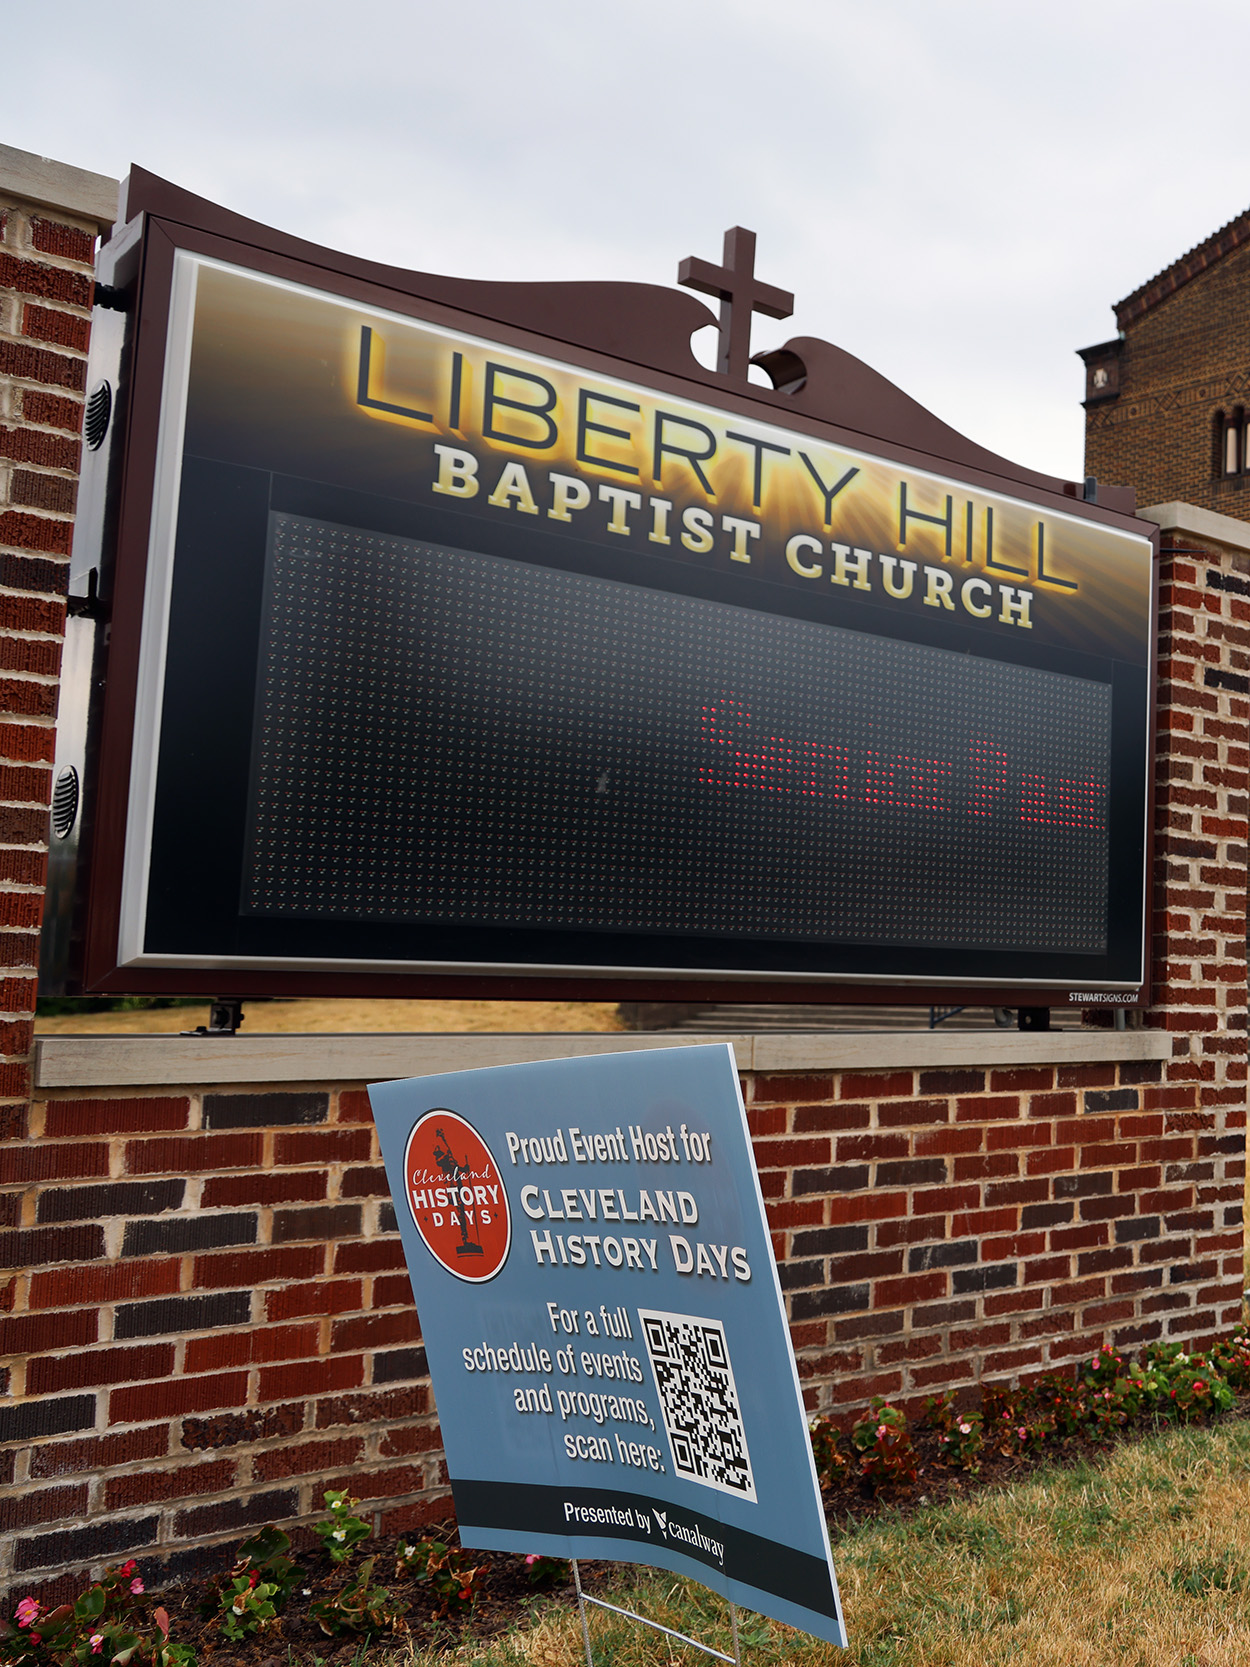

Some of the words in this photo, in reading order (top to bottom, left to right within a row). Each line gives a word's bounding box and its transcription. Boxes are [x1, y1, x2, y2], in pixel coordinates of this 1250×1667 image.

[356, 324, 861, 528] LIBERTY
[897, 480, 1079, 593] HILL
[431, 443, 761, 564] BAPTIST
[785, 533, 1034, 629] CHURCH
[1068, 992, 1139, 1003] STEWARTSIGNS.COM
[505, 1129, 569, 1165] Proud
[568, 1126, 629, 1162] Event
[628, 1125, 680, 1162] Host
[680, 1123, 712, 1163] for
[412, 1164, 492, 1186] Cleveland
[412, 1184, 499, 1210] HISTORY
[520, 1184, 699, 1225] CLEVELAND
[432, 1209, 492, 1228] DAYS
[529, 1229, 658, 1271] HISTORY
[668, 1233, 752, 1281] DAYS
[546, 1302, 580, 1334] For
[584, 1310, 600, 1336] a
[600, 1304, 633, 1339] full
[462, 1341, 553, 1373] schedule
[556, 1343, 577, 1375] of
[580, 1350, 644, 1383] events
[513, 1382, 553, 1413] and
[556, 1389, 656, 1432] programs,
[563, 1433, 614, 1462] scan
[614, 1433, 666, 1473] here:
[563, 1502, 635, 1528] Presented
[635, 1509, 652, 1535] by
[668, 1523, 725, 1567] canalway
